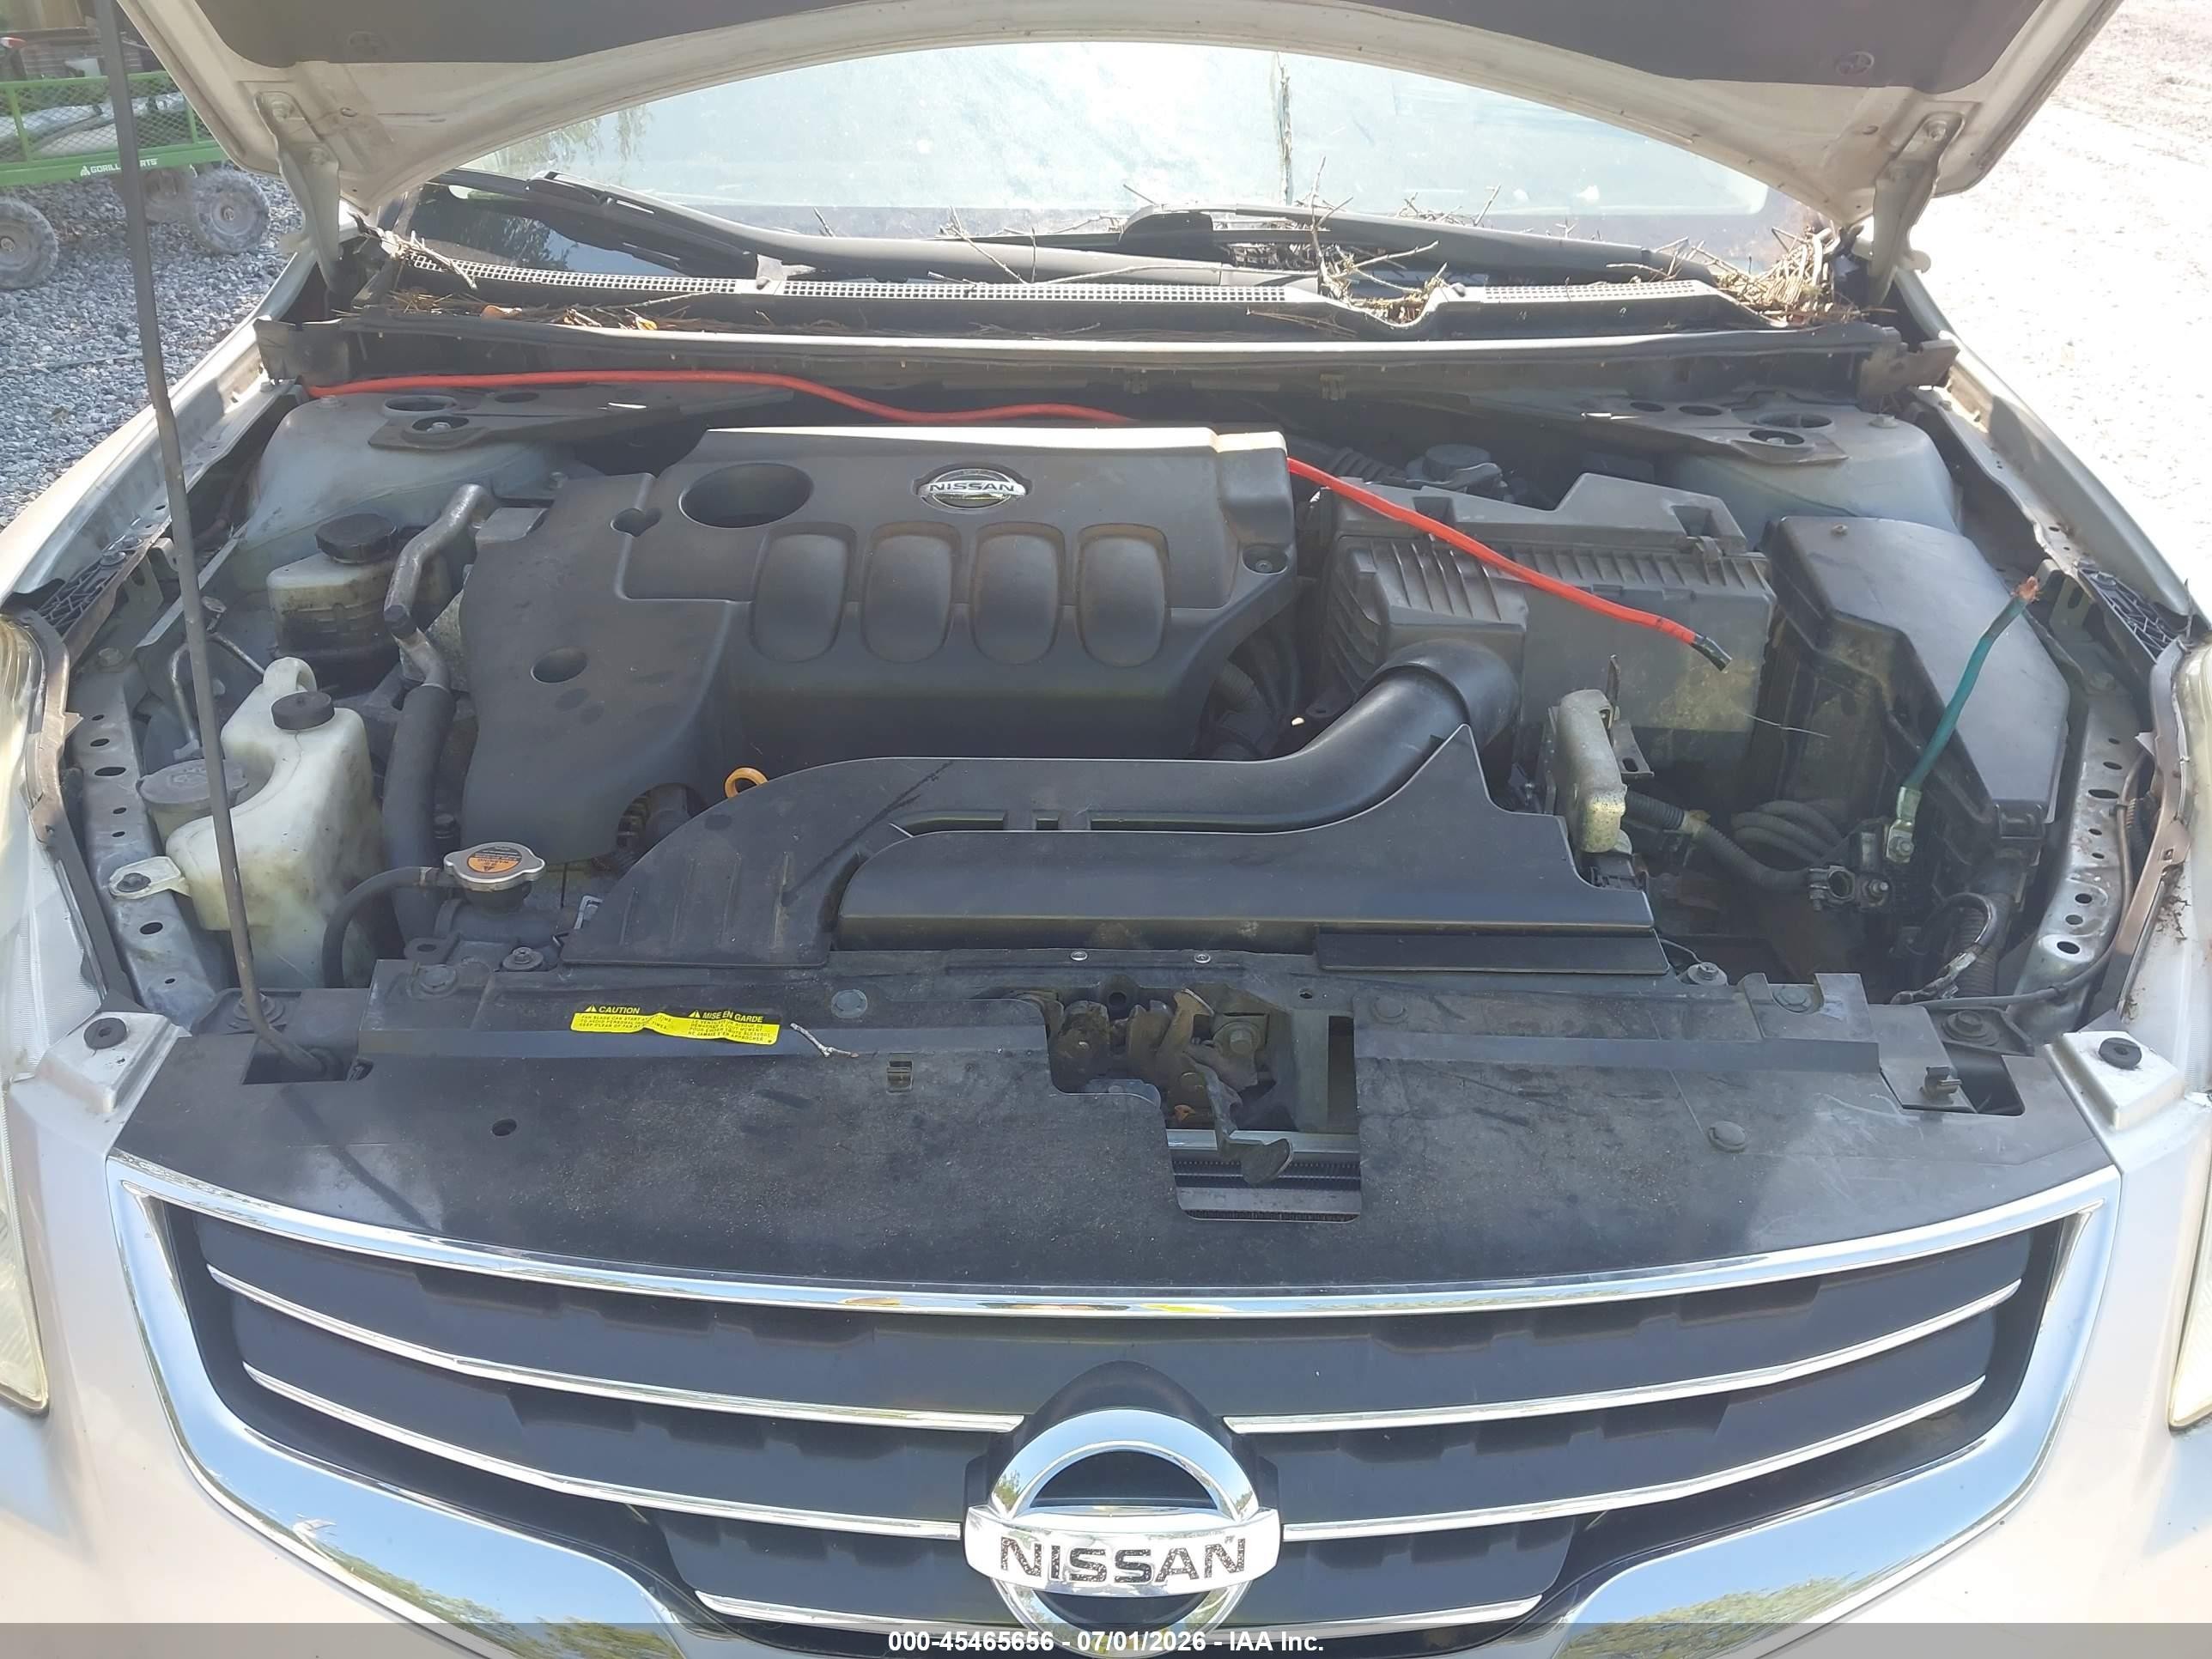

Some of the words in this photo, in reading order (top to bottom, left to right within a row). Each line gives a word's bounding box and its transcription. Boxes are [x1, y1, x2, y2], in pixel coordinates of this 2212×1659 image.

[90, 163, 121, 173] GORILL
[139, 158, 158, 167] RTS
[930, 483, 1014, 492] NISSAN
[599, 1006, 641, 1014] CAUTION
[722, 1011, 733, 1019] EN
[734, 1013, 763, 1023] GARDE
[1000, 1536, 1246, 1583] NISSAN
